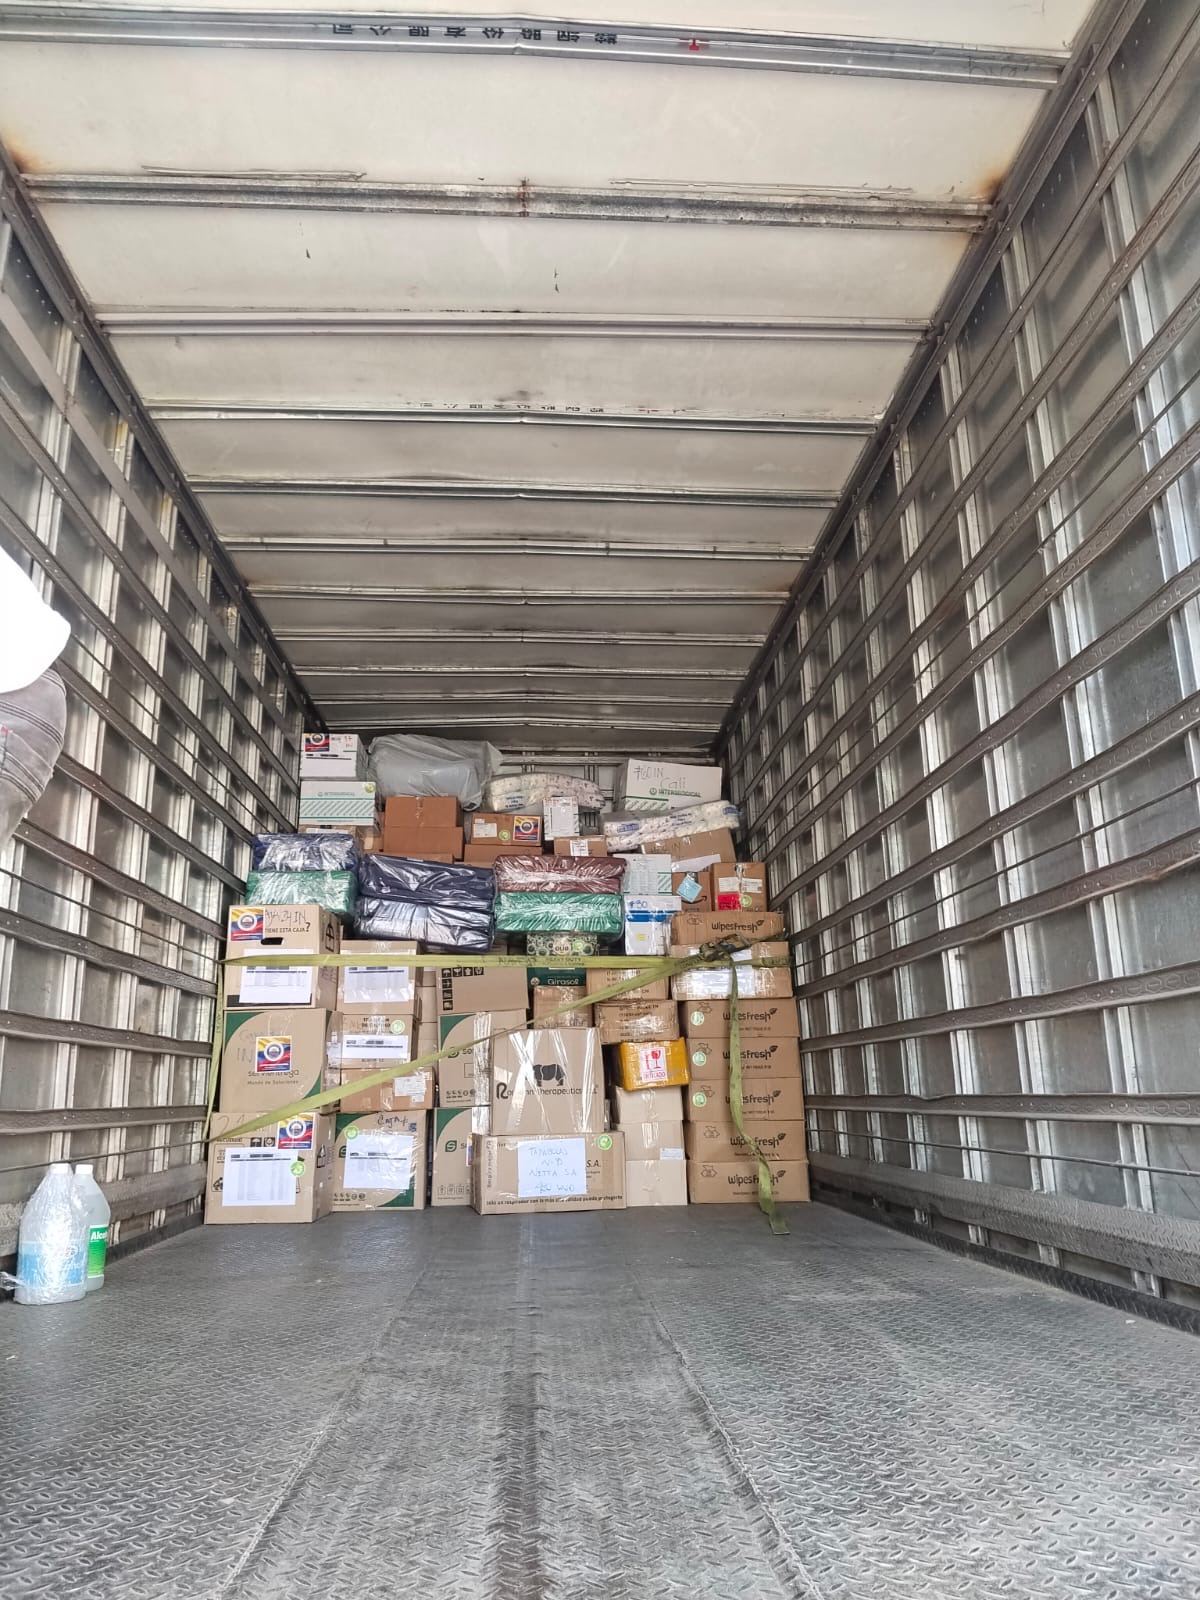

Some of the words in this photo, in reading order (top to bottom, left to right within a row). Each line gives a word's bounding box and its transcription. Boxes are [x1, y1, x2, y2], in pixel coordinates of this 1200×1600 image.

[711, 921, 758, 933] wipesfresh
[722, 1011, 771, 1022] wesfresh
[722, 1048, 772, 1060] wsfresh
[730, 1135, 779, 1148] wipfresh
[728, 1174, 779, 1186] wipesfrh
